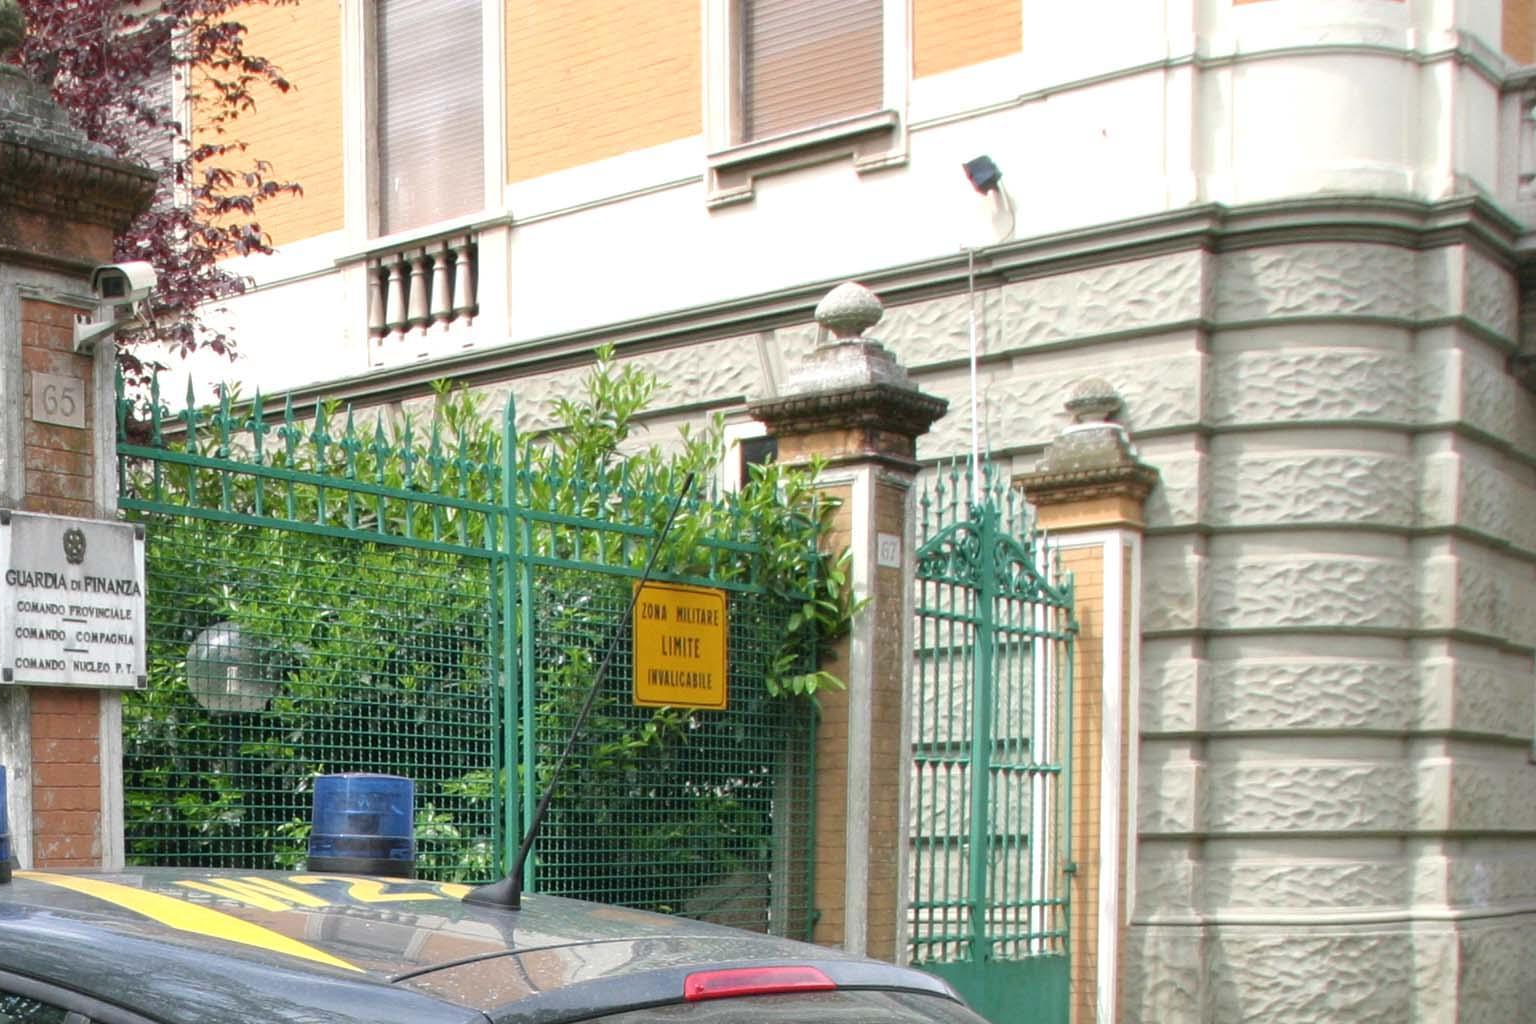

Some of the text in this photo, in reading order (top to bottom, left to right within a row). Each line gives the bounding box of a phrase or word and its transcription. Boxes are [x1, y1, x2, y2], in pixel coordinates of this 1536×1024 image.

[43, 383, 76, 417] 65
[5, 569, 68, 590] GUARDIA
[84, 576, 141, 597] FINANZA
[17, 601, 132, 620] COMANDO PROVINCIALE
[641, 602, 719, 626] ZONA MILITARE
[16, 627, 134, 645] COMANDO COMPAGNIA
[661, 635, 700, 658] LIMITE
[15, 657, 65, 670] COMANDO
[73, 661, 111, 673] NUCLEO
[647, 668, 712, 689] INVALICABILE
